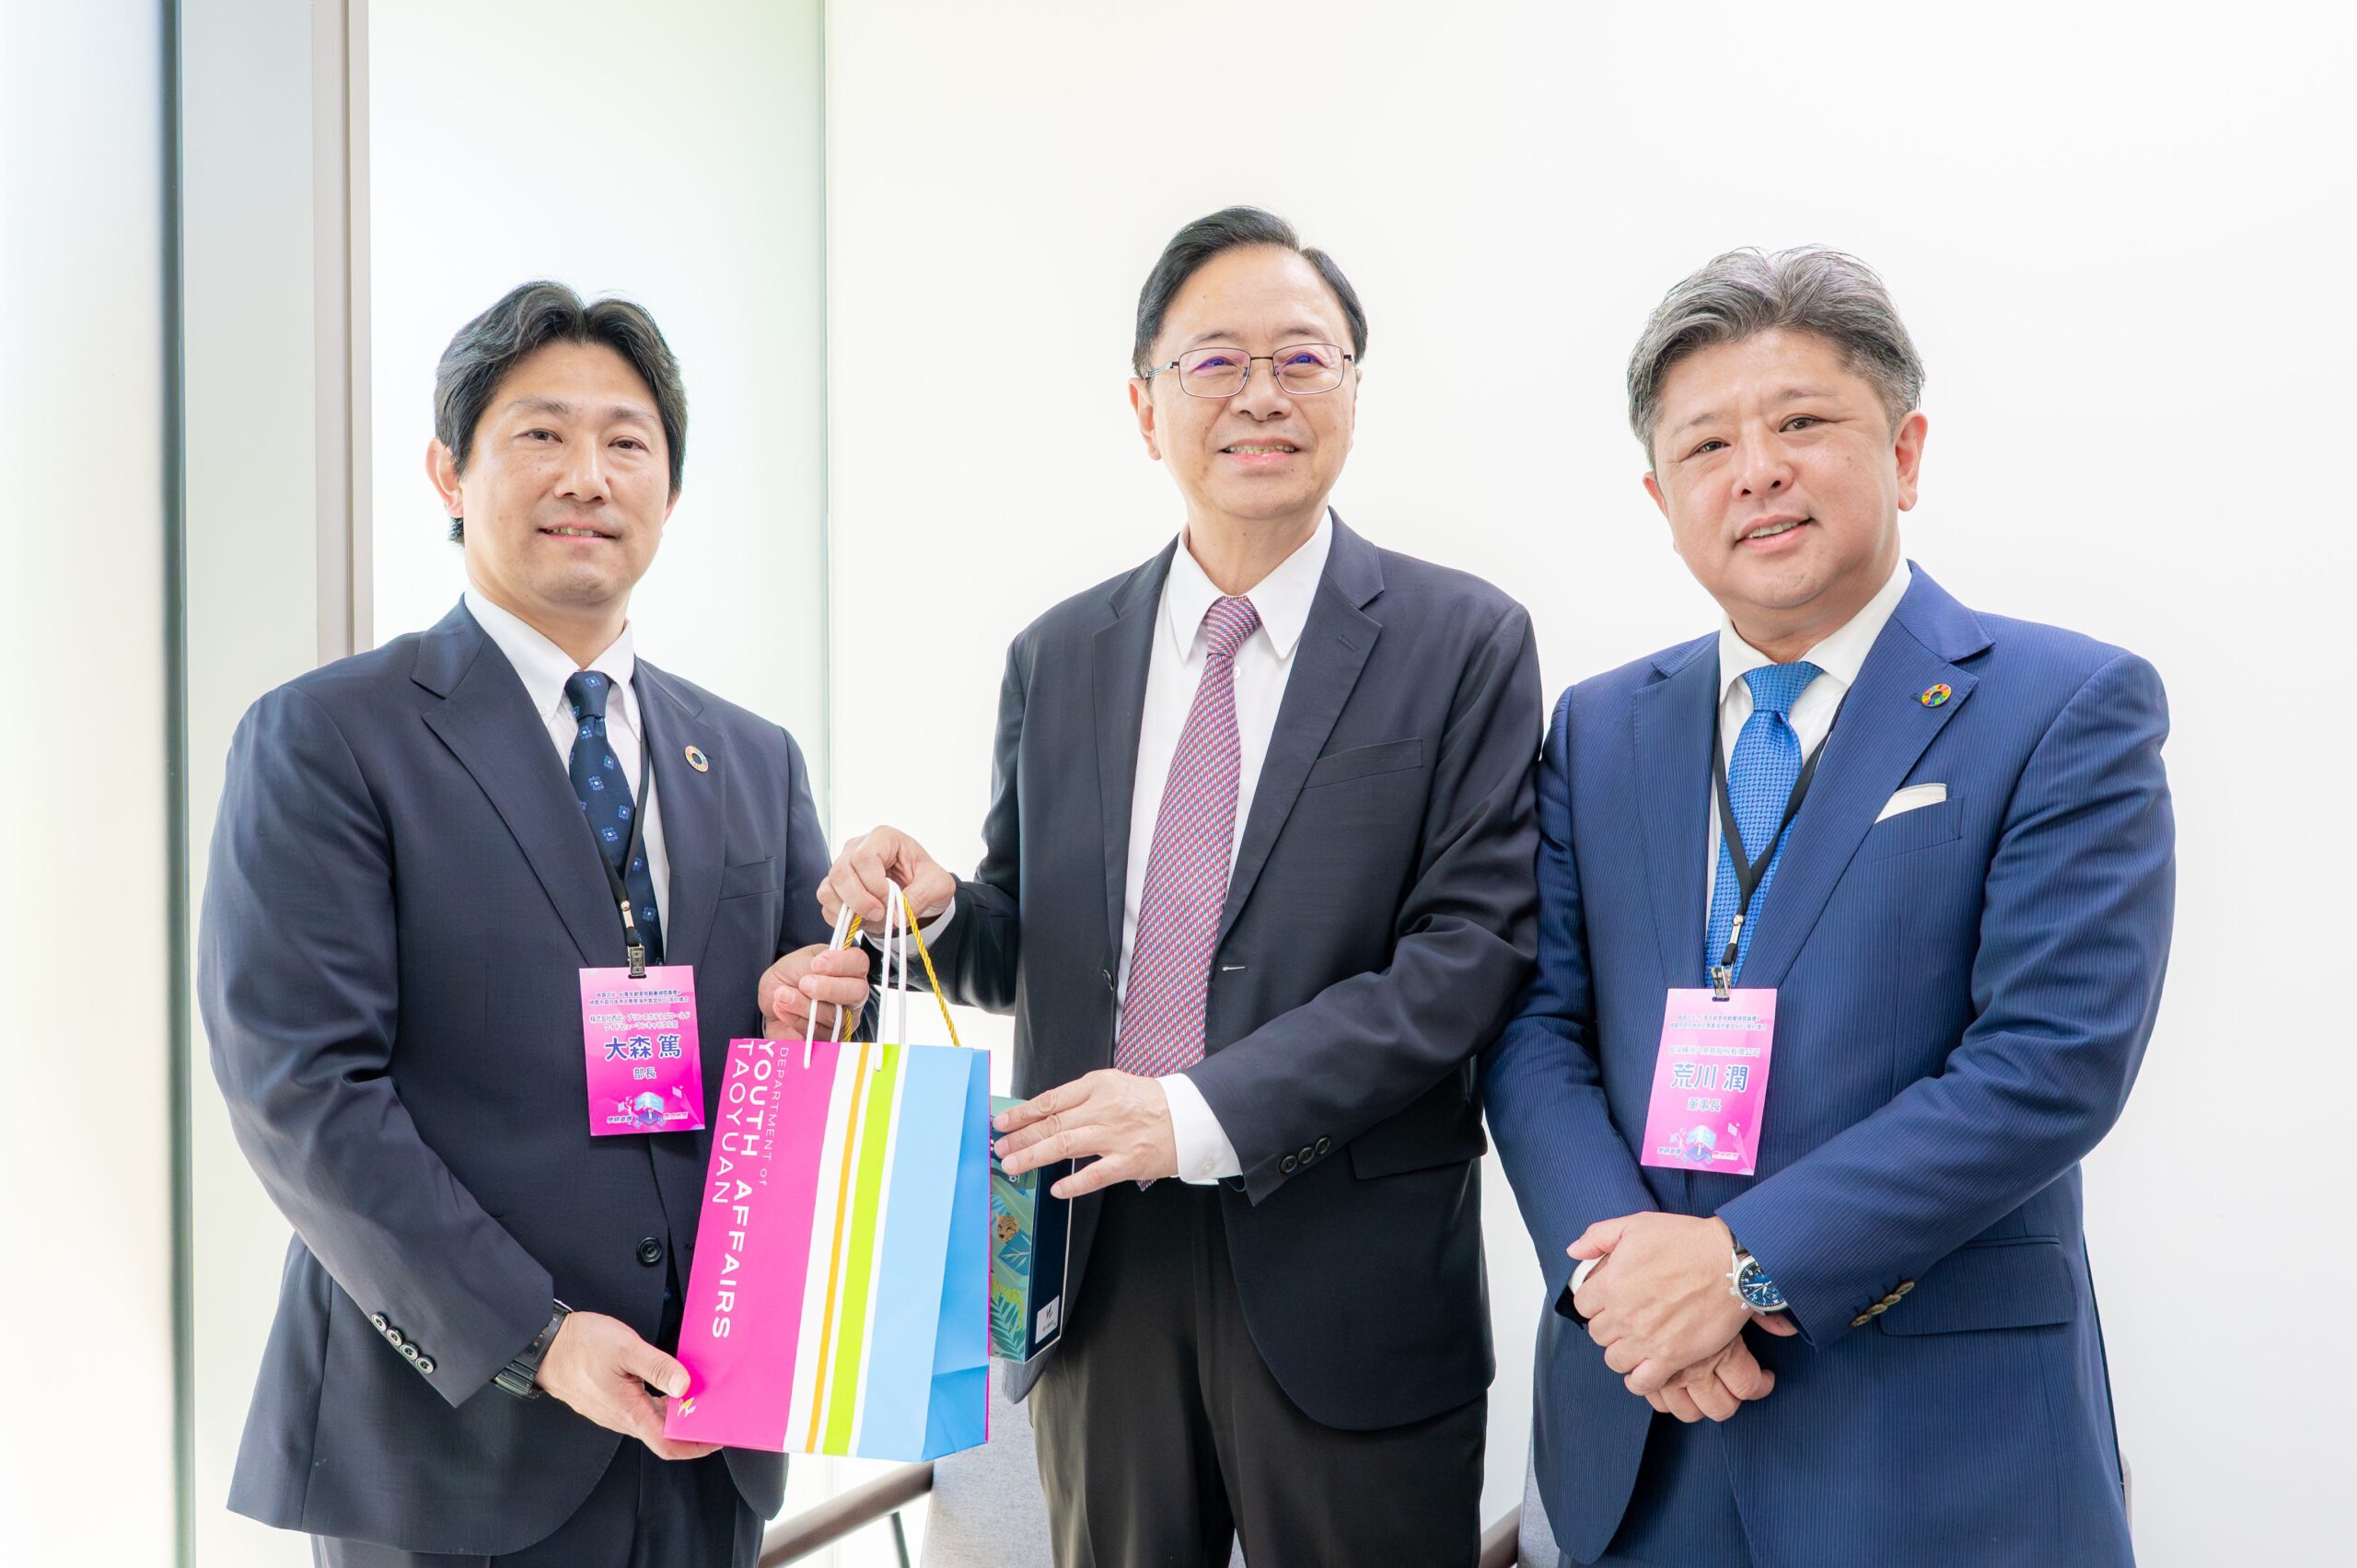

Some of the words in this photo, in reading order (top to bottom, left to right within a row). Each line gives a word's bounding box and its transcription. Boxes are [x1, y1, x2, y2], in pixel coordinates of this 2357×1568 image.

[605, 1036, 652, 1061] 大森
[658, 1035, 680, 1058] 篤
[633, 1068, 656, 1079] 部長
[1671, 1063, 1718, 1089] 荒川
[1723, 1065, 1748, 1091] 潤
[739, 1040, 776, 1156] YOUTH
[761, 1047, 789, 1162] DEPARTMENT
[1688, 1098, 1722, 1112] 董事長
[712, 1040, 755, 1203] TAOYUAN
[759, 1168, 768, 1186] of
[712, 1179, 753, 1340] AFFAIRS
